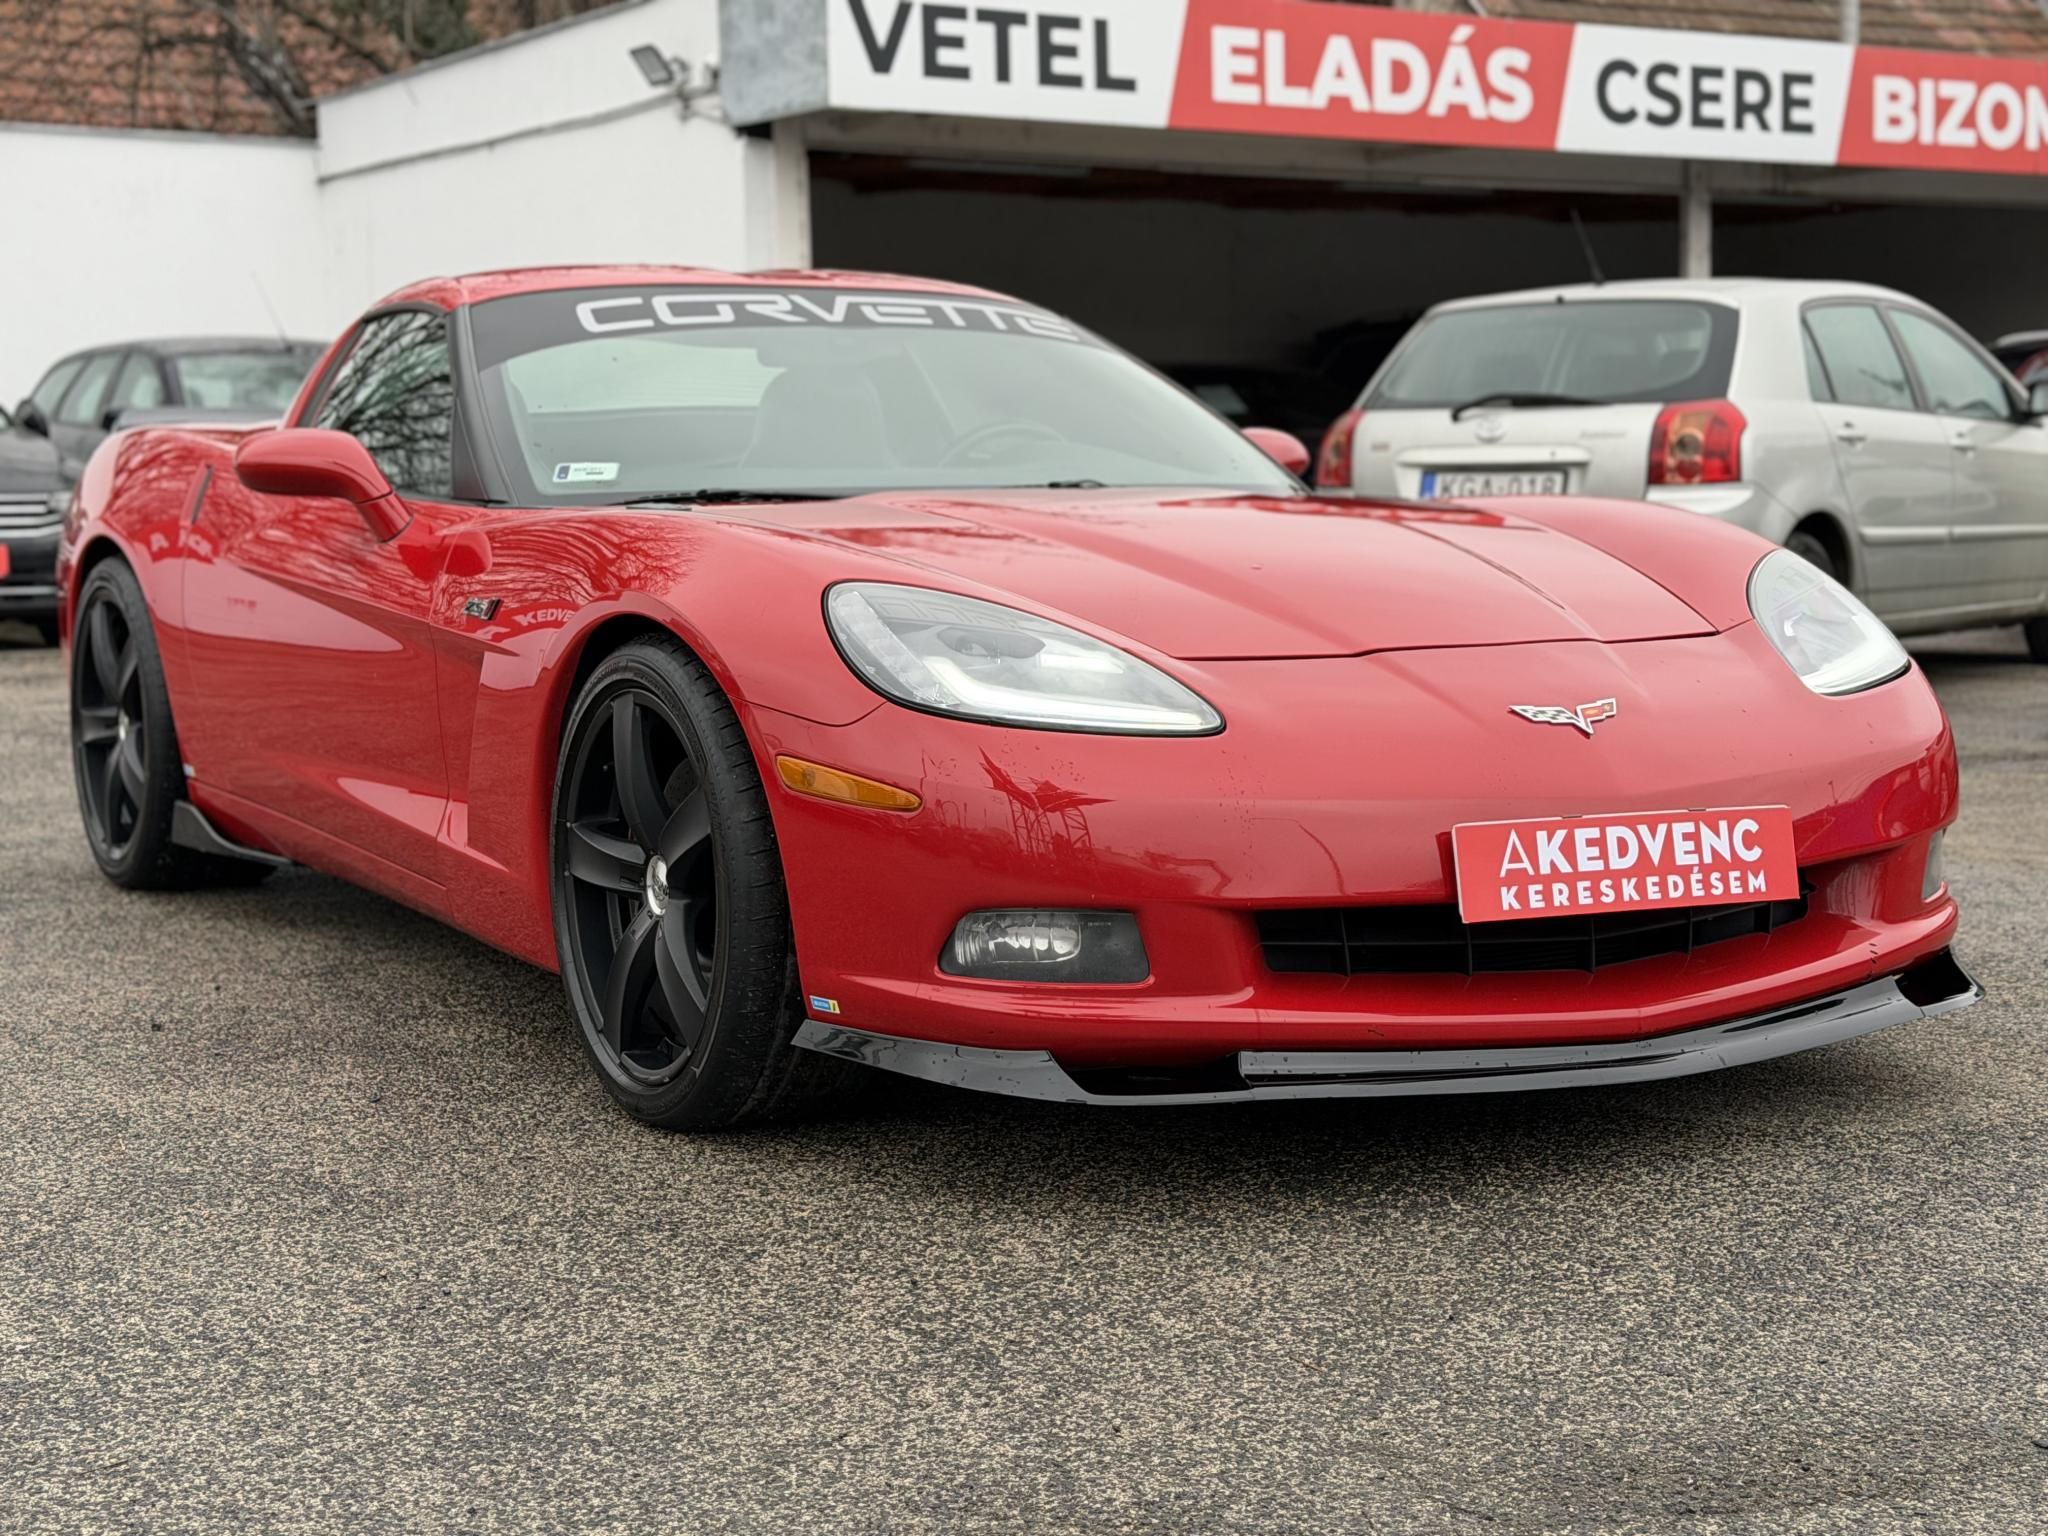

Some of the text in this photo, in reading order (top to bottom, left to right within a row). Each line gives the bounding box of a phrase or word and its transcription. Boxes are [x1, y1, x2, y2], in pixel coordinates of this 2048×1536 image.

[847, 0, 1137, 93] VETEL
[1209, 24, 1535, 123] ELADÁS
[1595, 59, 1815, 135] CSERE
[575, 293, 1080, 342] CORVETTE
[1500, 866, 1767, 911] KERESKEDÉSEM
